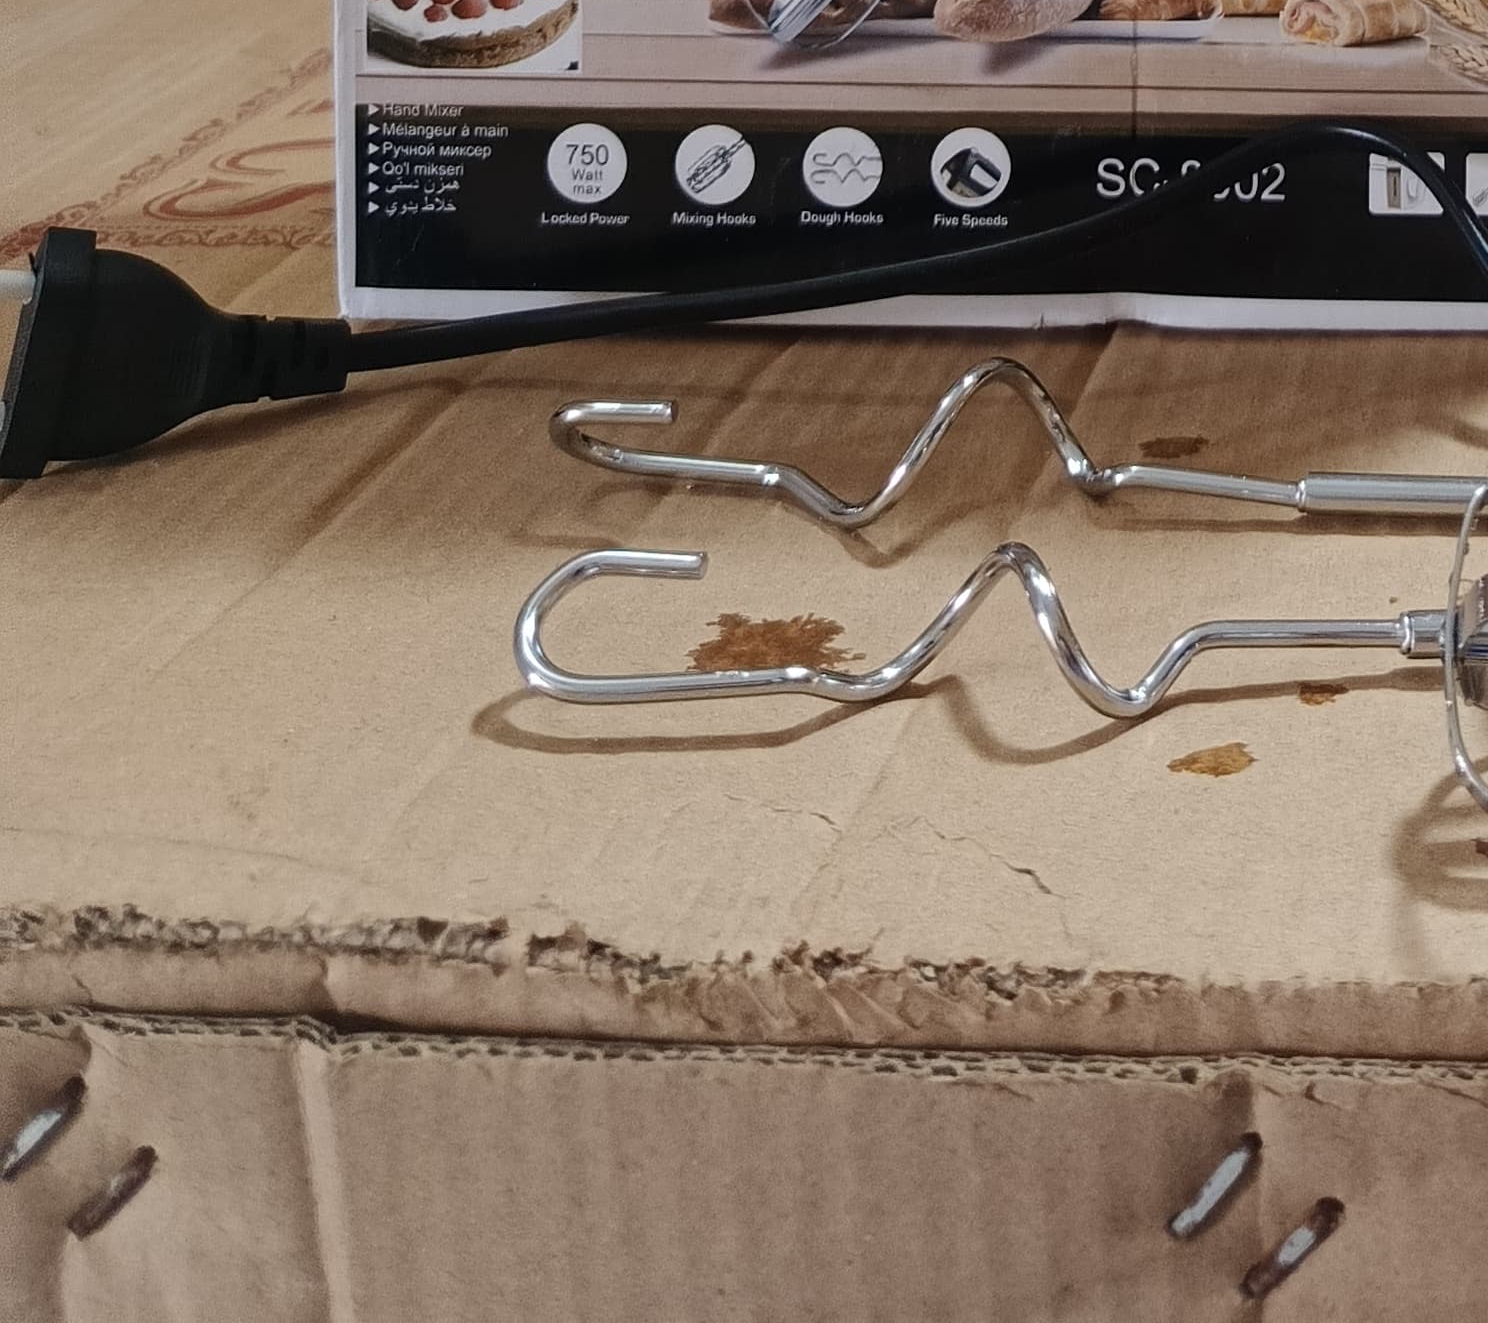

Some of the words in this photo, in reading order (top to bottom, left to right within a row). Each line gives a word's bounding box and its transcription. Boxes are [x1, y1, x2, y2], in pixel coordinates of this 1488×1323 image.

[382, 101, 420, 117] Hand
[425, 102, 464, 117] Mixer
[382, 122, 458, 139] Mélangeur
[474, 123, 509, 137] main
[382, 141, 435, 158] Ручной
[440, 144, 492, 159] миксер
[566, 144, 609, 166] 750
[414, 162, 464, 176] mikseri
[571, 168, 603, 181] Watt
[1096, 157, 1286, 201] SC02
[573, 182, 601, 195] max
[541, 211, 587, 224] Locked
[589, 212, 630, 225] Power
[672, 211, 714, 227] Mixing
[716, 212, 756, 225] Hooks
[801, 210, 841, 226] Dough
[844, 211, 884, 224] Hooks
[933, 213, 959, 226] Five
[962, 213, 1009, 227] Speeds
